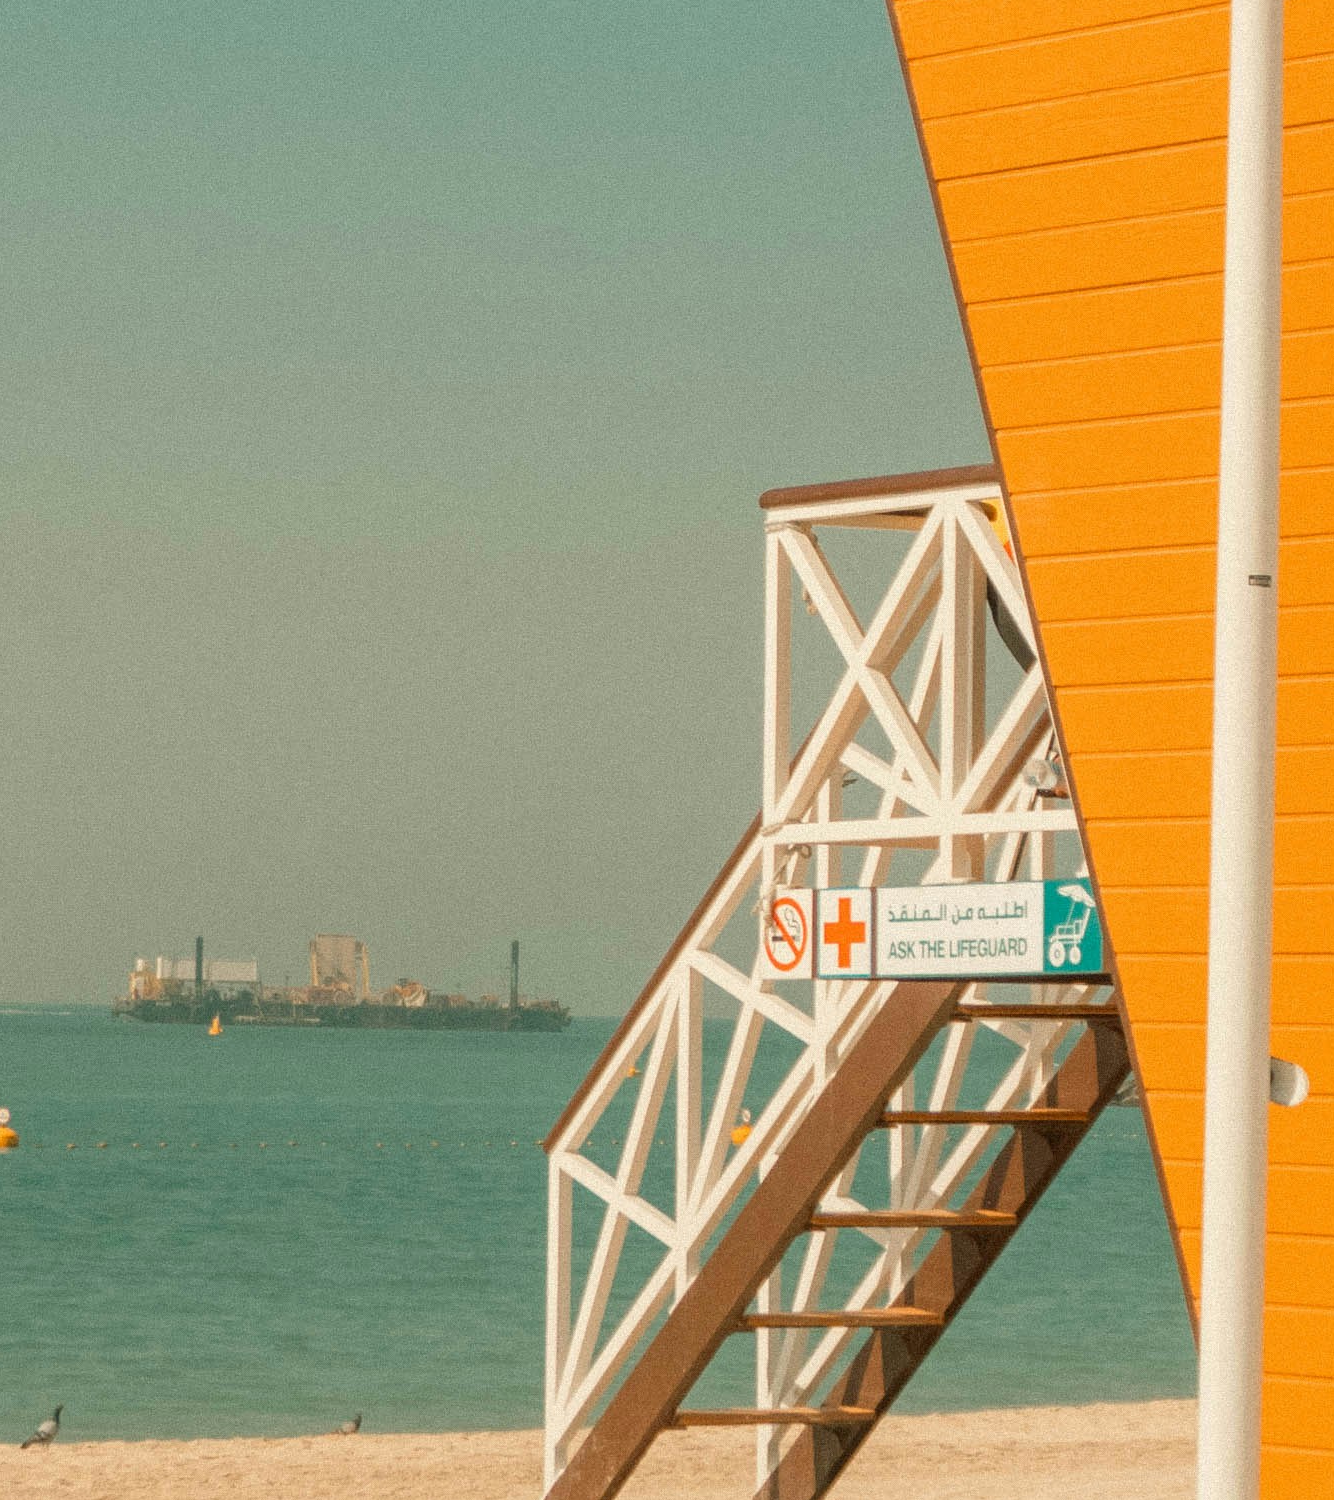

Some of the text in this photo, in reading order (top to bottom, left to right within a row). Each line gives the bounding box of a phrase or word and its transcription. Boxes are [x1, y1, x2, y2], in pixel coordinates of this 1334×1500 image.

[951, 904, 973, 925] من
[888, 937, 1027, 959] ASK THE LIFEGUARD
